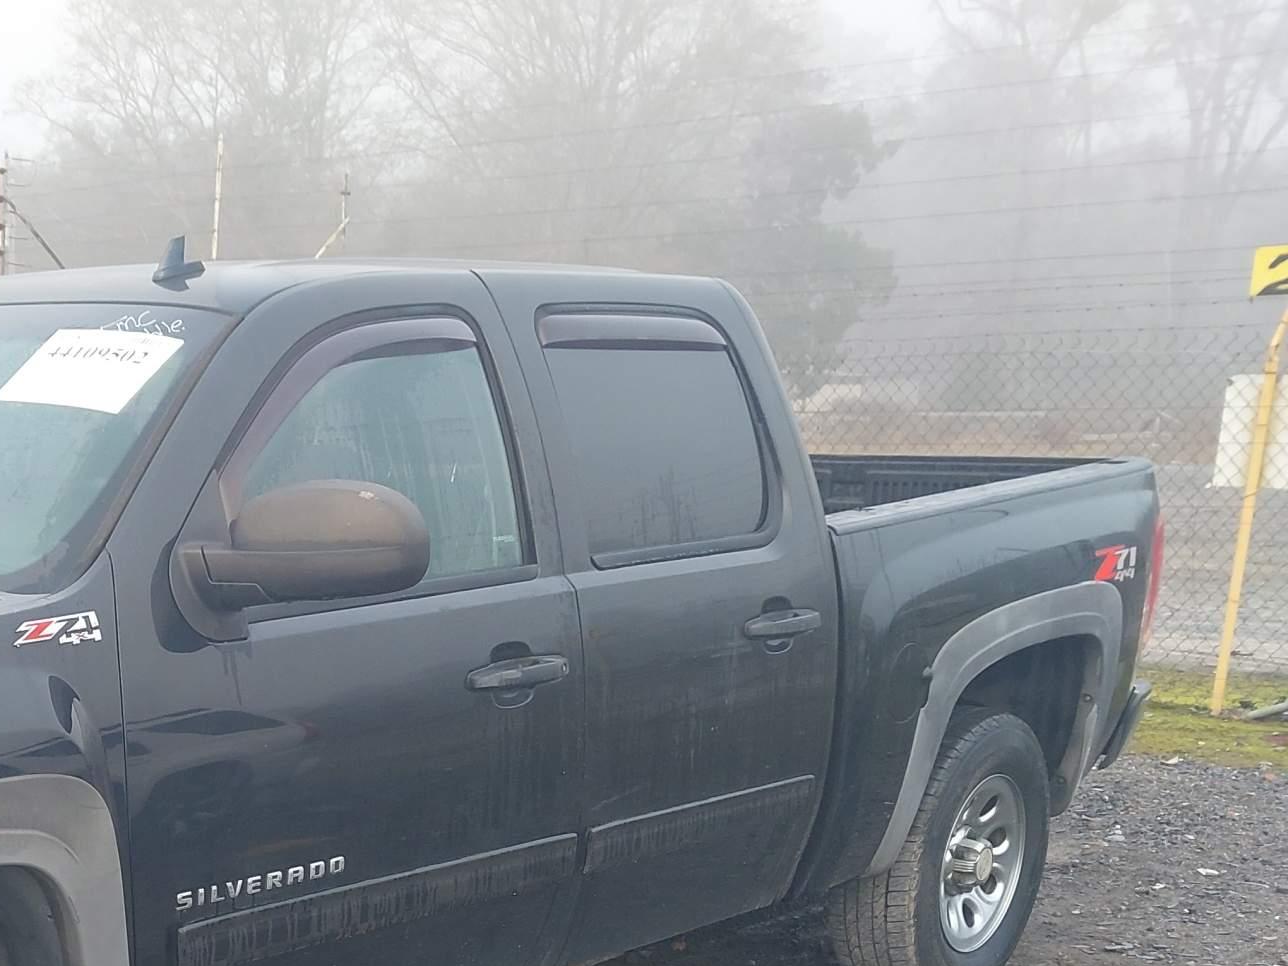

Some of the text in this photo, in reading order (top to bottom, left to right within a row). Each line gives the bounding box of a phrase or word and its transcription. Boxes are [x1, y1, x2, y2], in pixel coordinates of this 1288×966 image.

[48, 346, 149, 364] 44109502
[1095, 545, 1137, 580] Z71
[13, 611, 99, 647] Z71
[175, 855, 345, 911] SILVERADO
